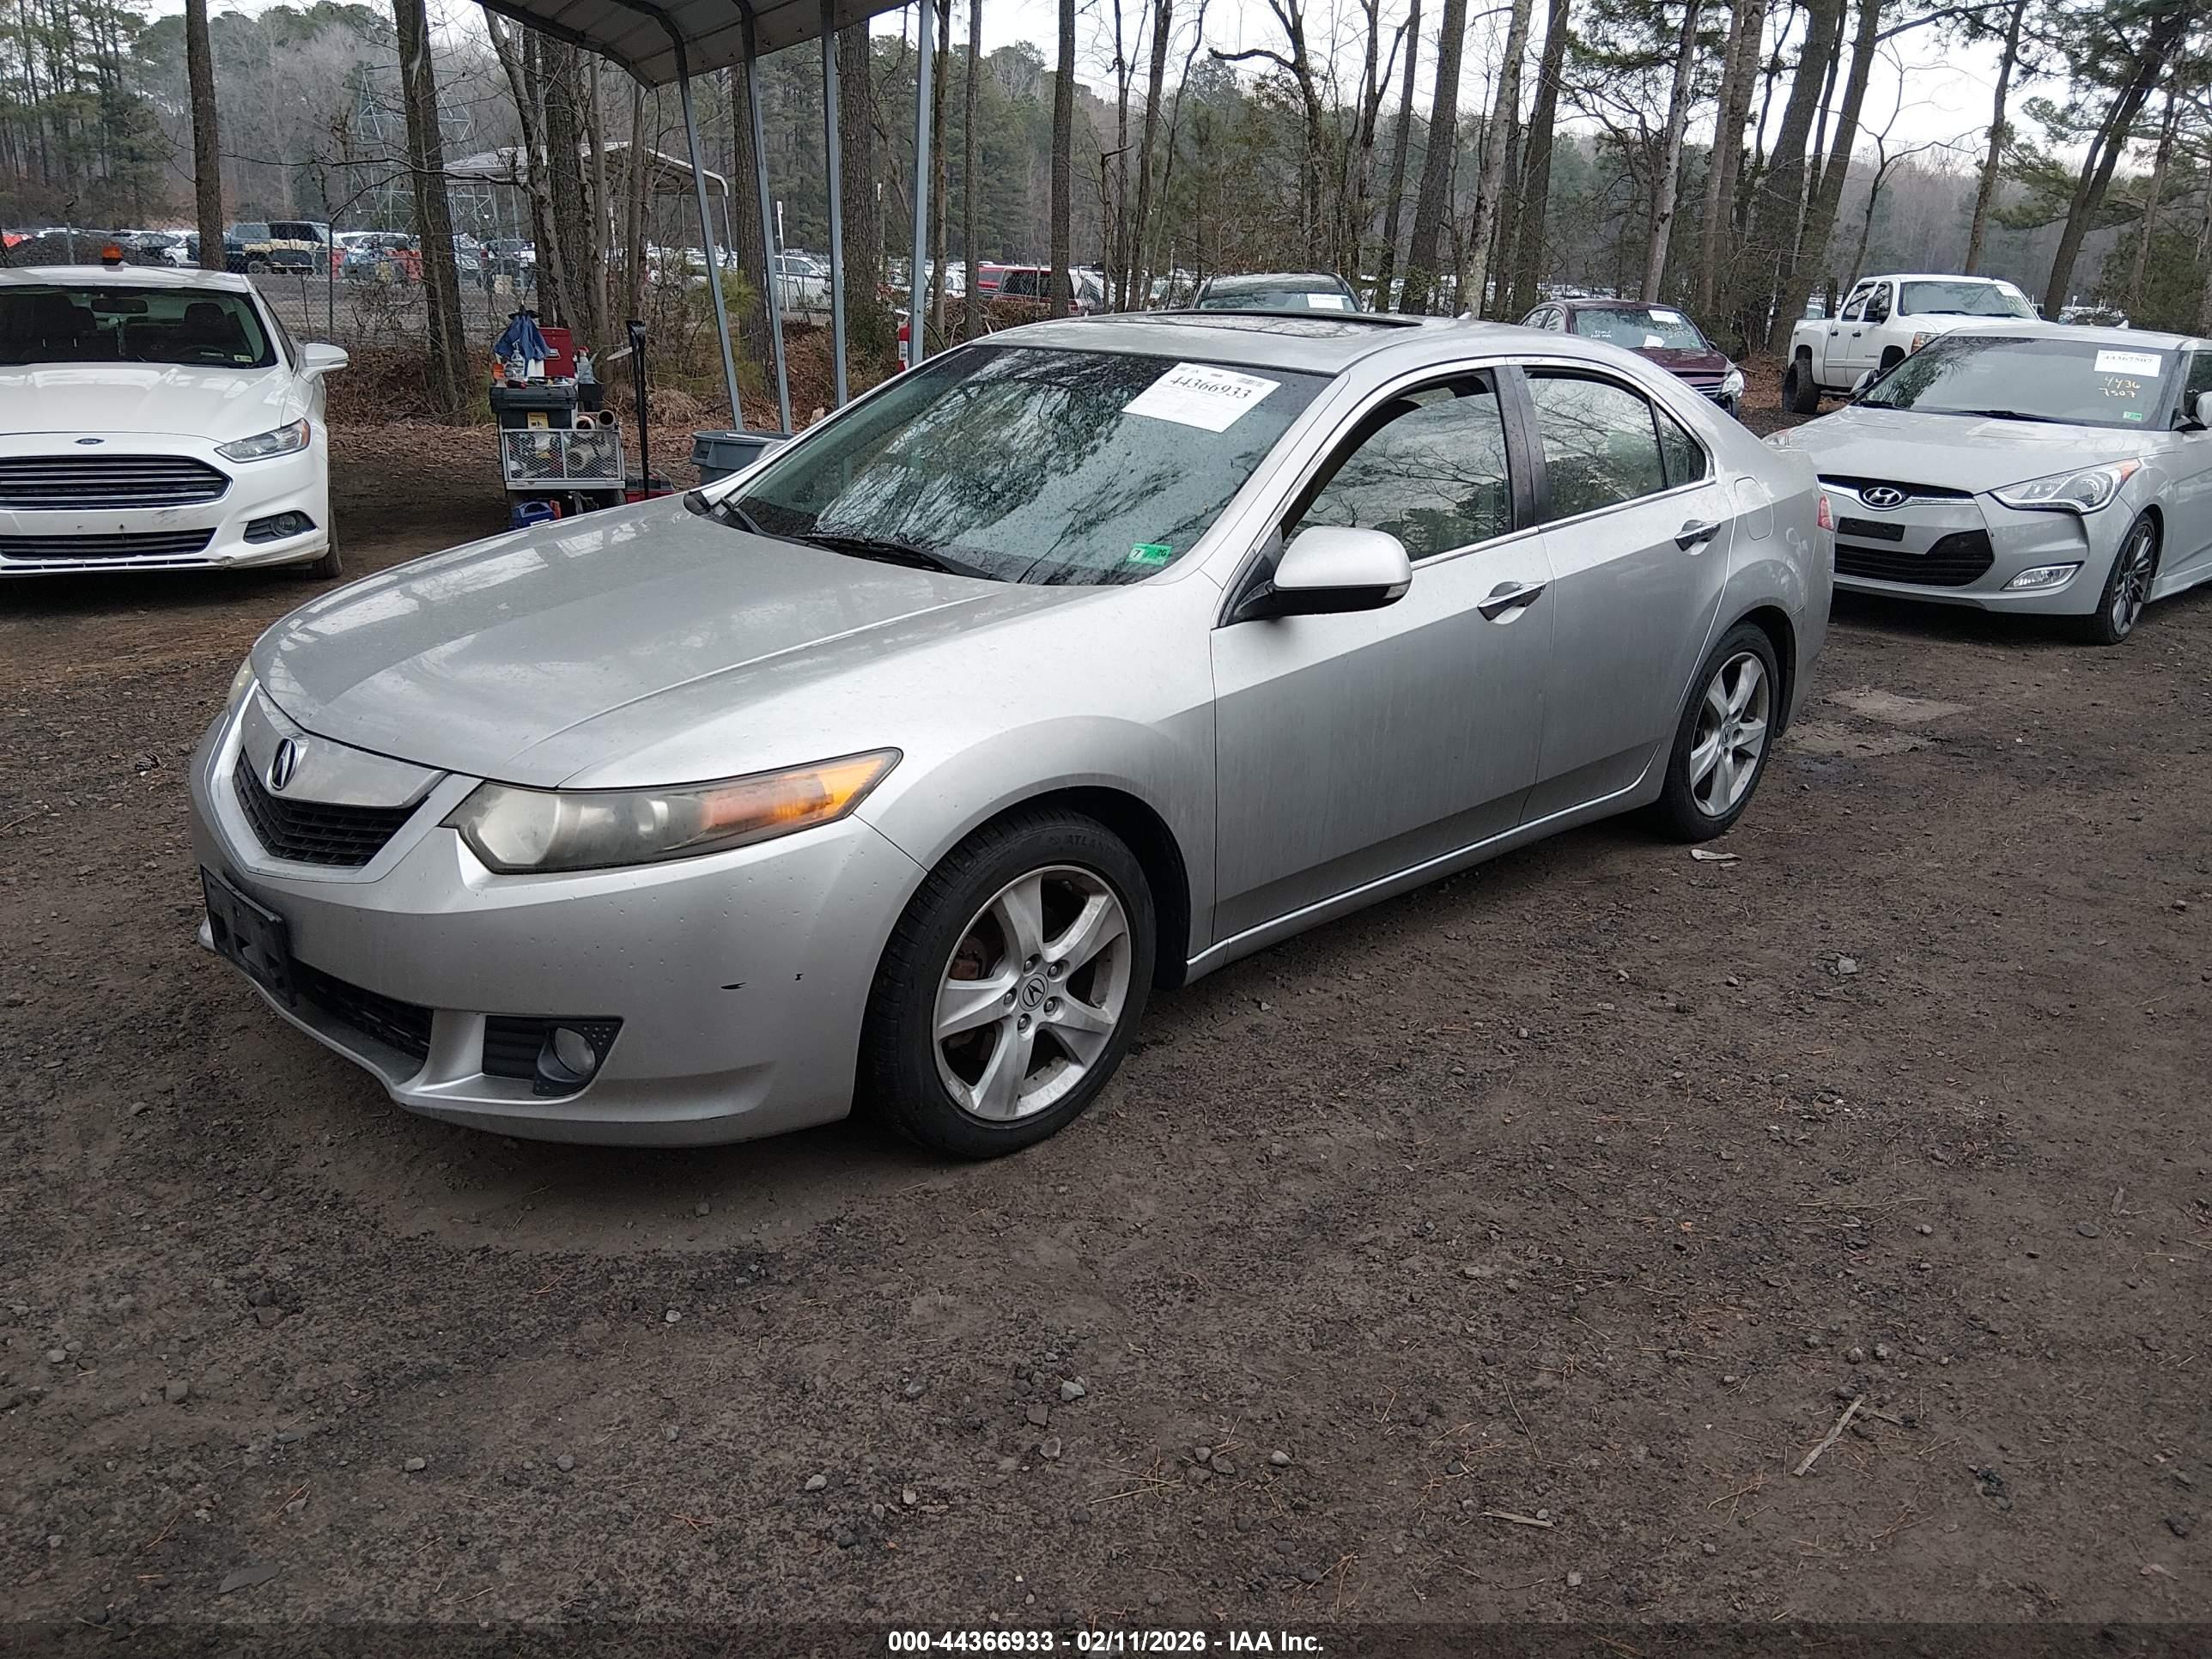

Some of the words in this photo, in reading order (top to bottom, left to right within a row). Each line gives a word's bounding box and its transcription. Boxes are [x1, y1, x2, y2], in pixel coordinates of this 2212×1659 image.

[1170, 376, 1252, 398] 44366933
[2105, 376, 2142, 389] 4436
[2098, 387, 2136, 398] 7507
[1133, 550, 1141, 558] 7
